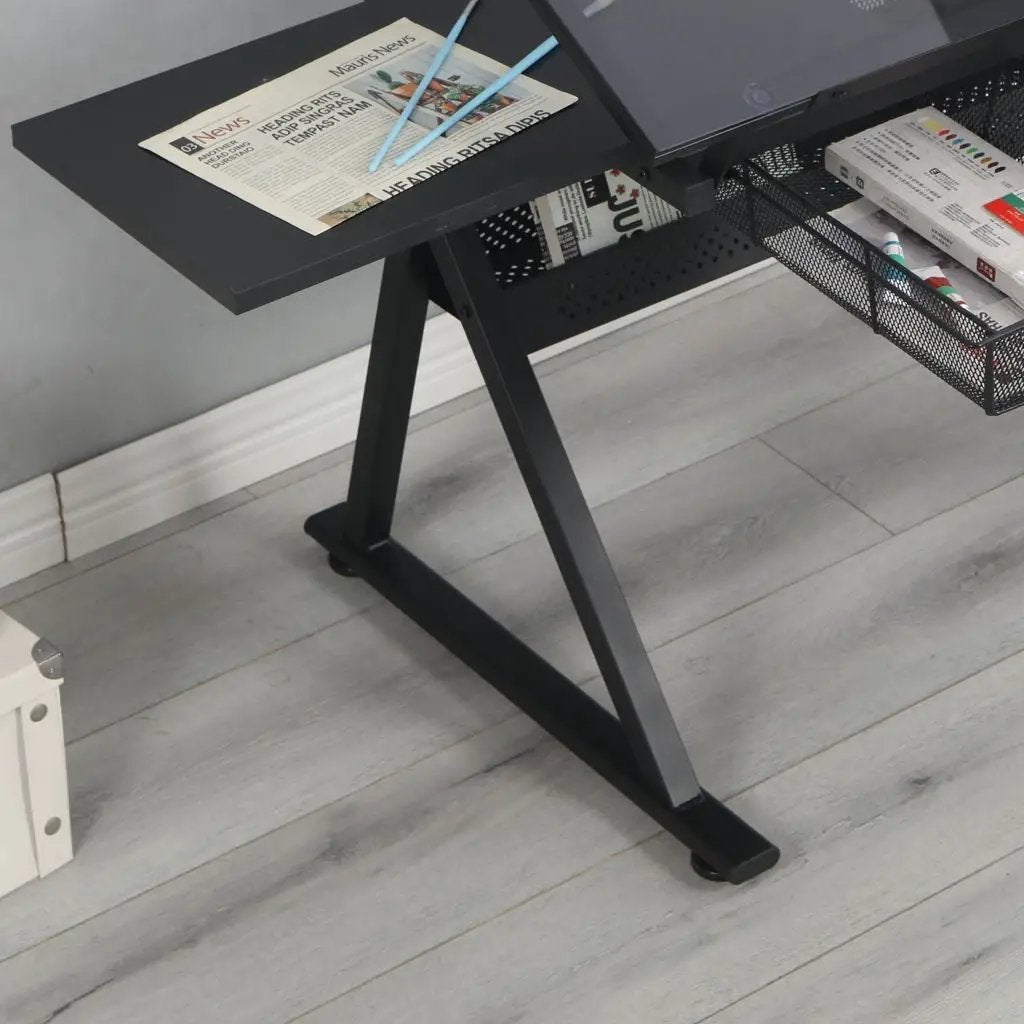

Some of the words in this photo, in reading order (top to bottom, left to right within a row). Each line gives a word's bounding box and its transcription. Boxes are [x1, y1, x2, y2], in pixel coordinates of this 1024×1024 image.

[328, 52, 379, 77] Mauris
[373, 34, 416, 58] News
[257, 104, 312, 134] HEADING
[311, 90, 342, 110] RITS
[271, 122, 299, 141] ADIP
[299, 96, 354, 125] SINGRAS
[283, 117, 341, 146] TEMPAST
[339, 100, 373, 119] NAM
[181, 142, 198, 153] 03
[192, 117, 250, 144] News
[198, 140, 237, 161] ANOTHER
[204, 151, 229, 165] HEAD
[382, 156, 460, 197] HEADING
